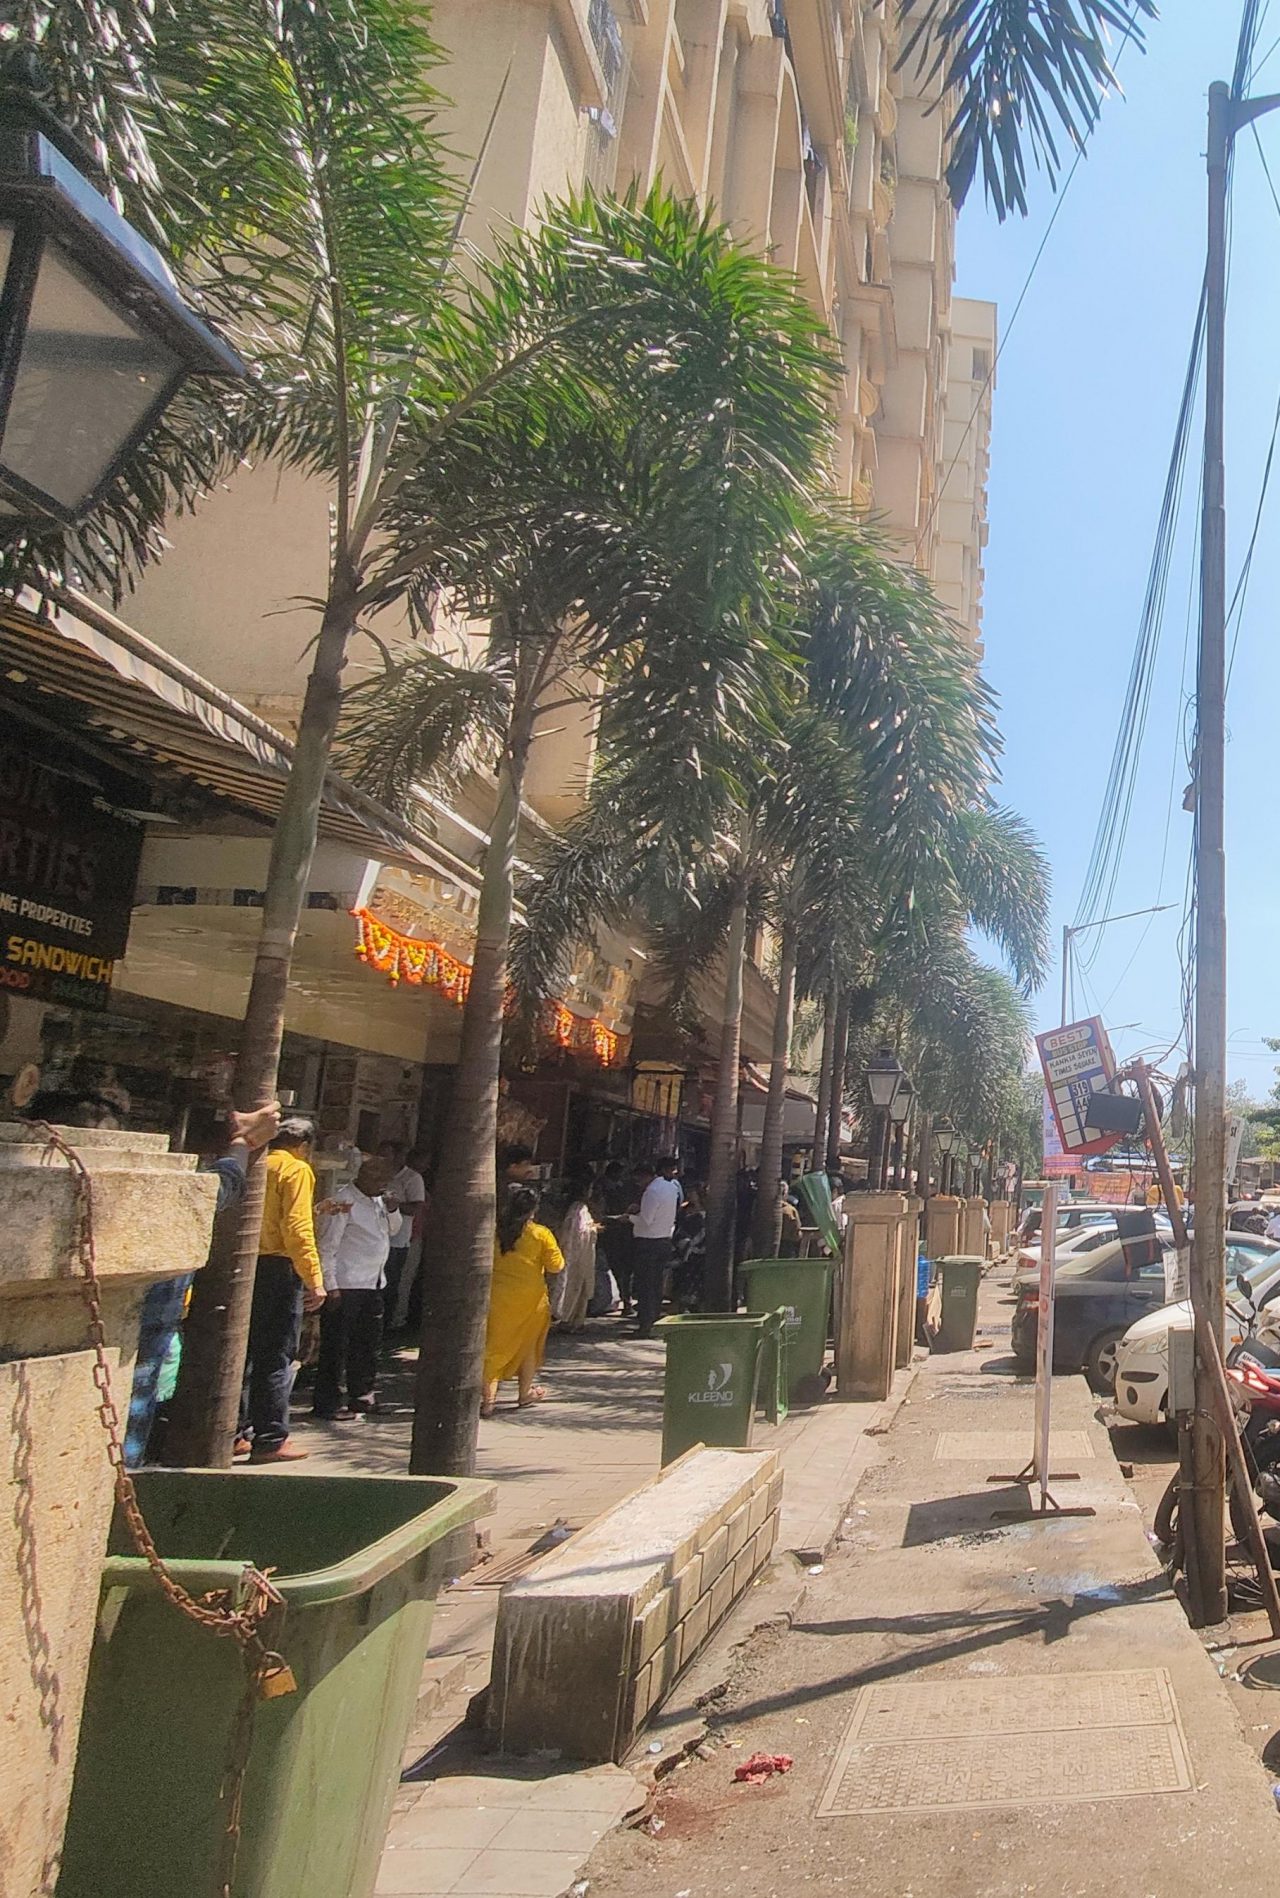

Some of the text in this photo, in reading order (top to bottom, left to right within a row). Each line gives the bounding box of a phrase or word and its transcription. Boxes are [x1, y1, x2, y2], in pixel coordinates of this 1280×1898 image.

[19, 899, 94, 936] PROPERTIES
[7, 935, 114, 985] SANDWICH
[1050, 1028, 1085, 1049] BEST
[1077, 1047, 1097, 1059] SEVEN
[1054, 1057, 1096, 1077] TIMES SQUARE
[1072, 1081, 1088, 1096] 319
